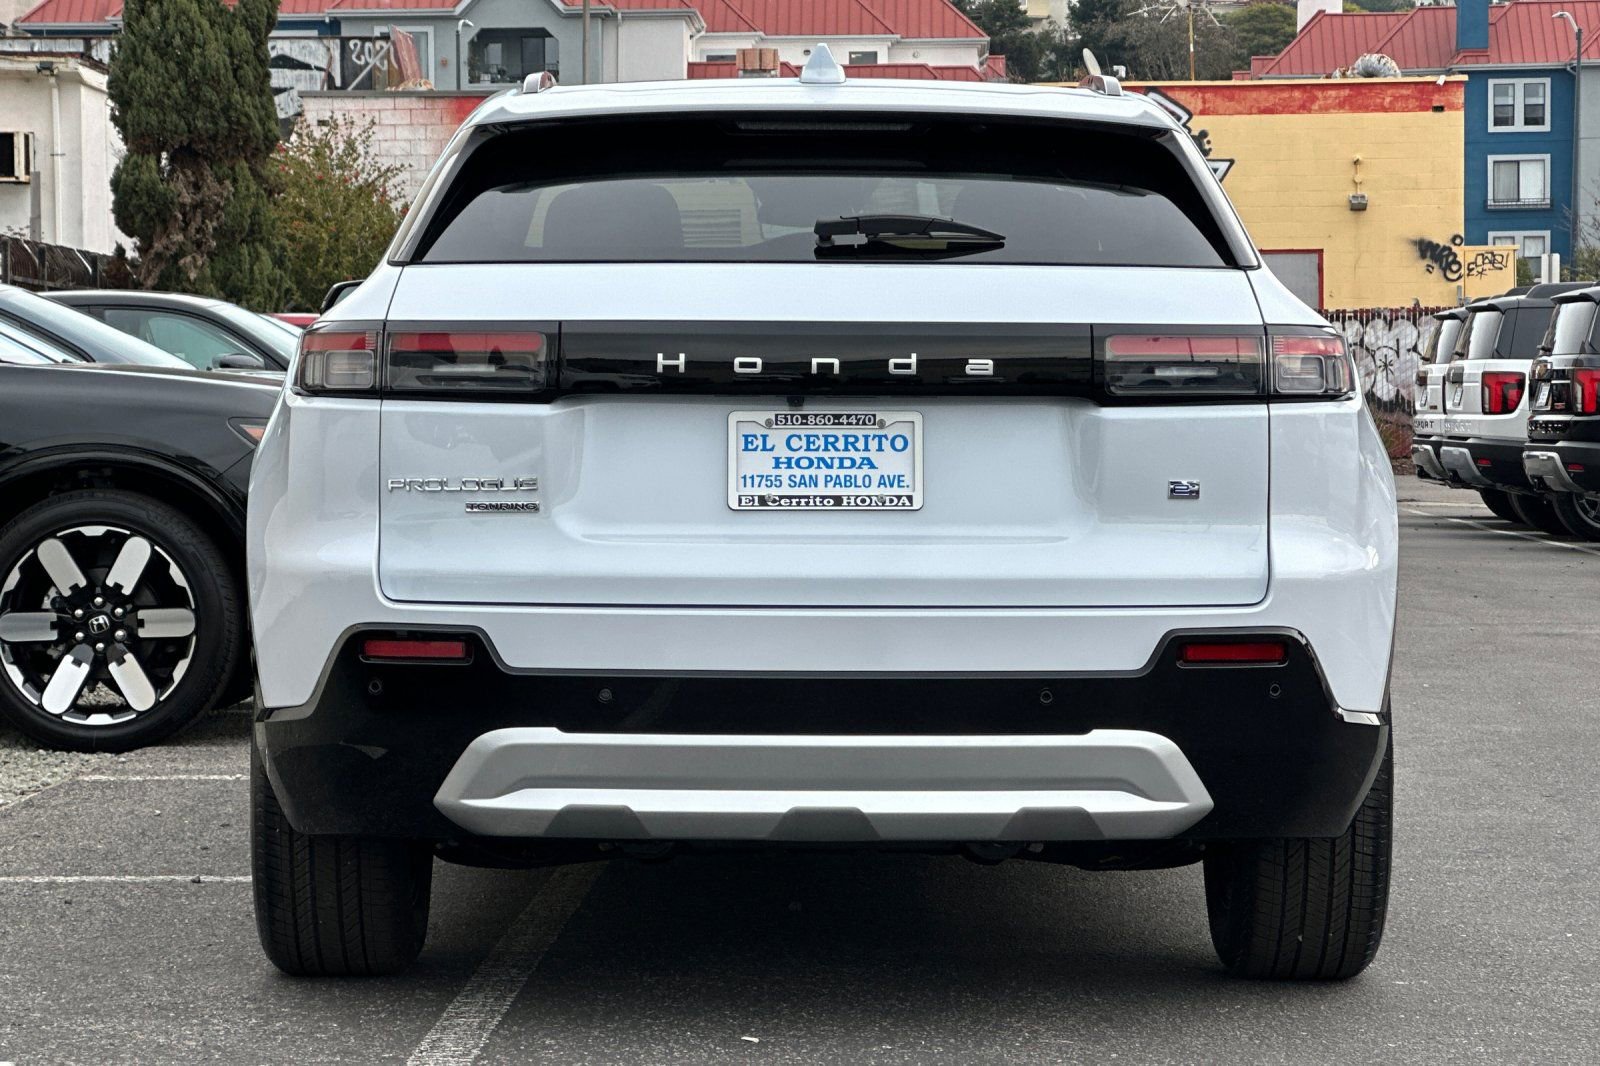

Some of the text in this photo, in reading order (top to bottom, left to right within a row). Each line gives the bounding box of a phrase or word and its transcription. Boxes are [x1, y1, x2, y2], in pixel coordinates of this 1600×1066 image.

[656, 352, 994, 376] Honda
[777, 414, 875, 426] 510-860-4470
[741, 433, 909, 452] EL CERRITO
[772, 456, 879, 470] HONDA
[387, 477, 539, 492] PROLOGUE
[740, 474, 910, 489] 11755 SAN PABLO AVE.
[466, 502, 539, 512] TOURING
[739, 495, 911, 507] El Cerrito HONDA
